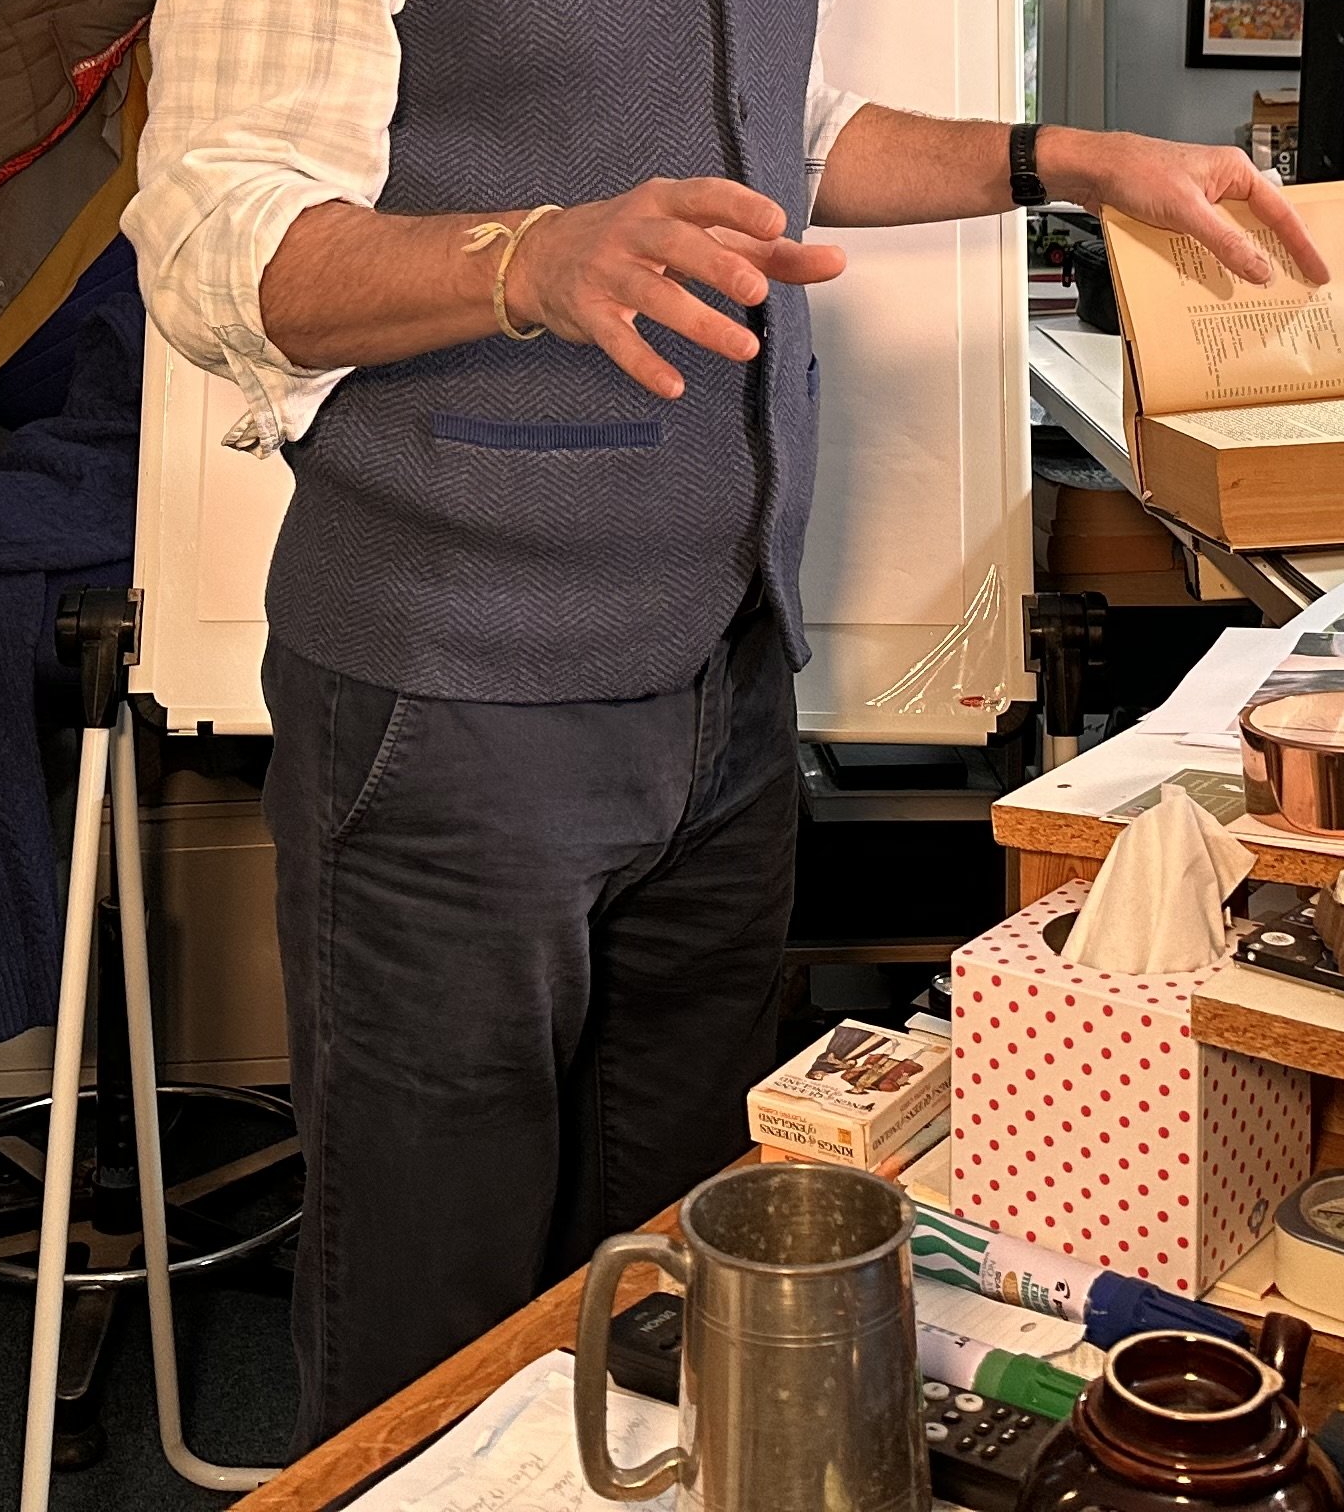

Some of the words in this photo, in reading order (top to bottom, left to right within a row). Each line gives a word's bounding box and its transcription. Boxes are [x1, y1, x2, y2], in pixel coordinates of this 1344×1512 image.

[758, 1113, 806, 1134] ENGLAND
[759, 1123, 807, 1144] QUEENS
[817, 1139, 855, 1158] KINGS
[639, 1310, 678, 1333] DENON
